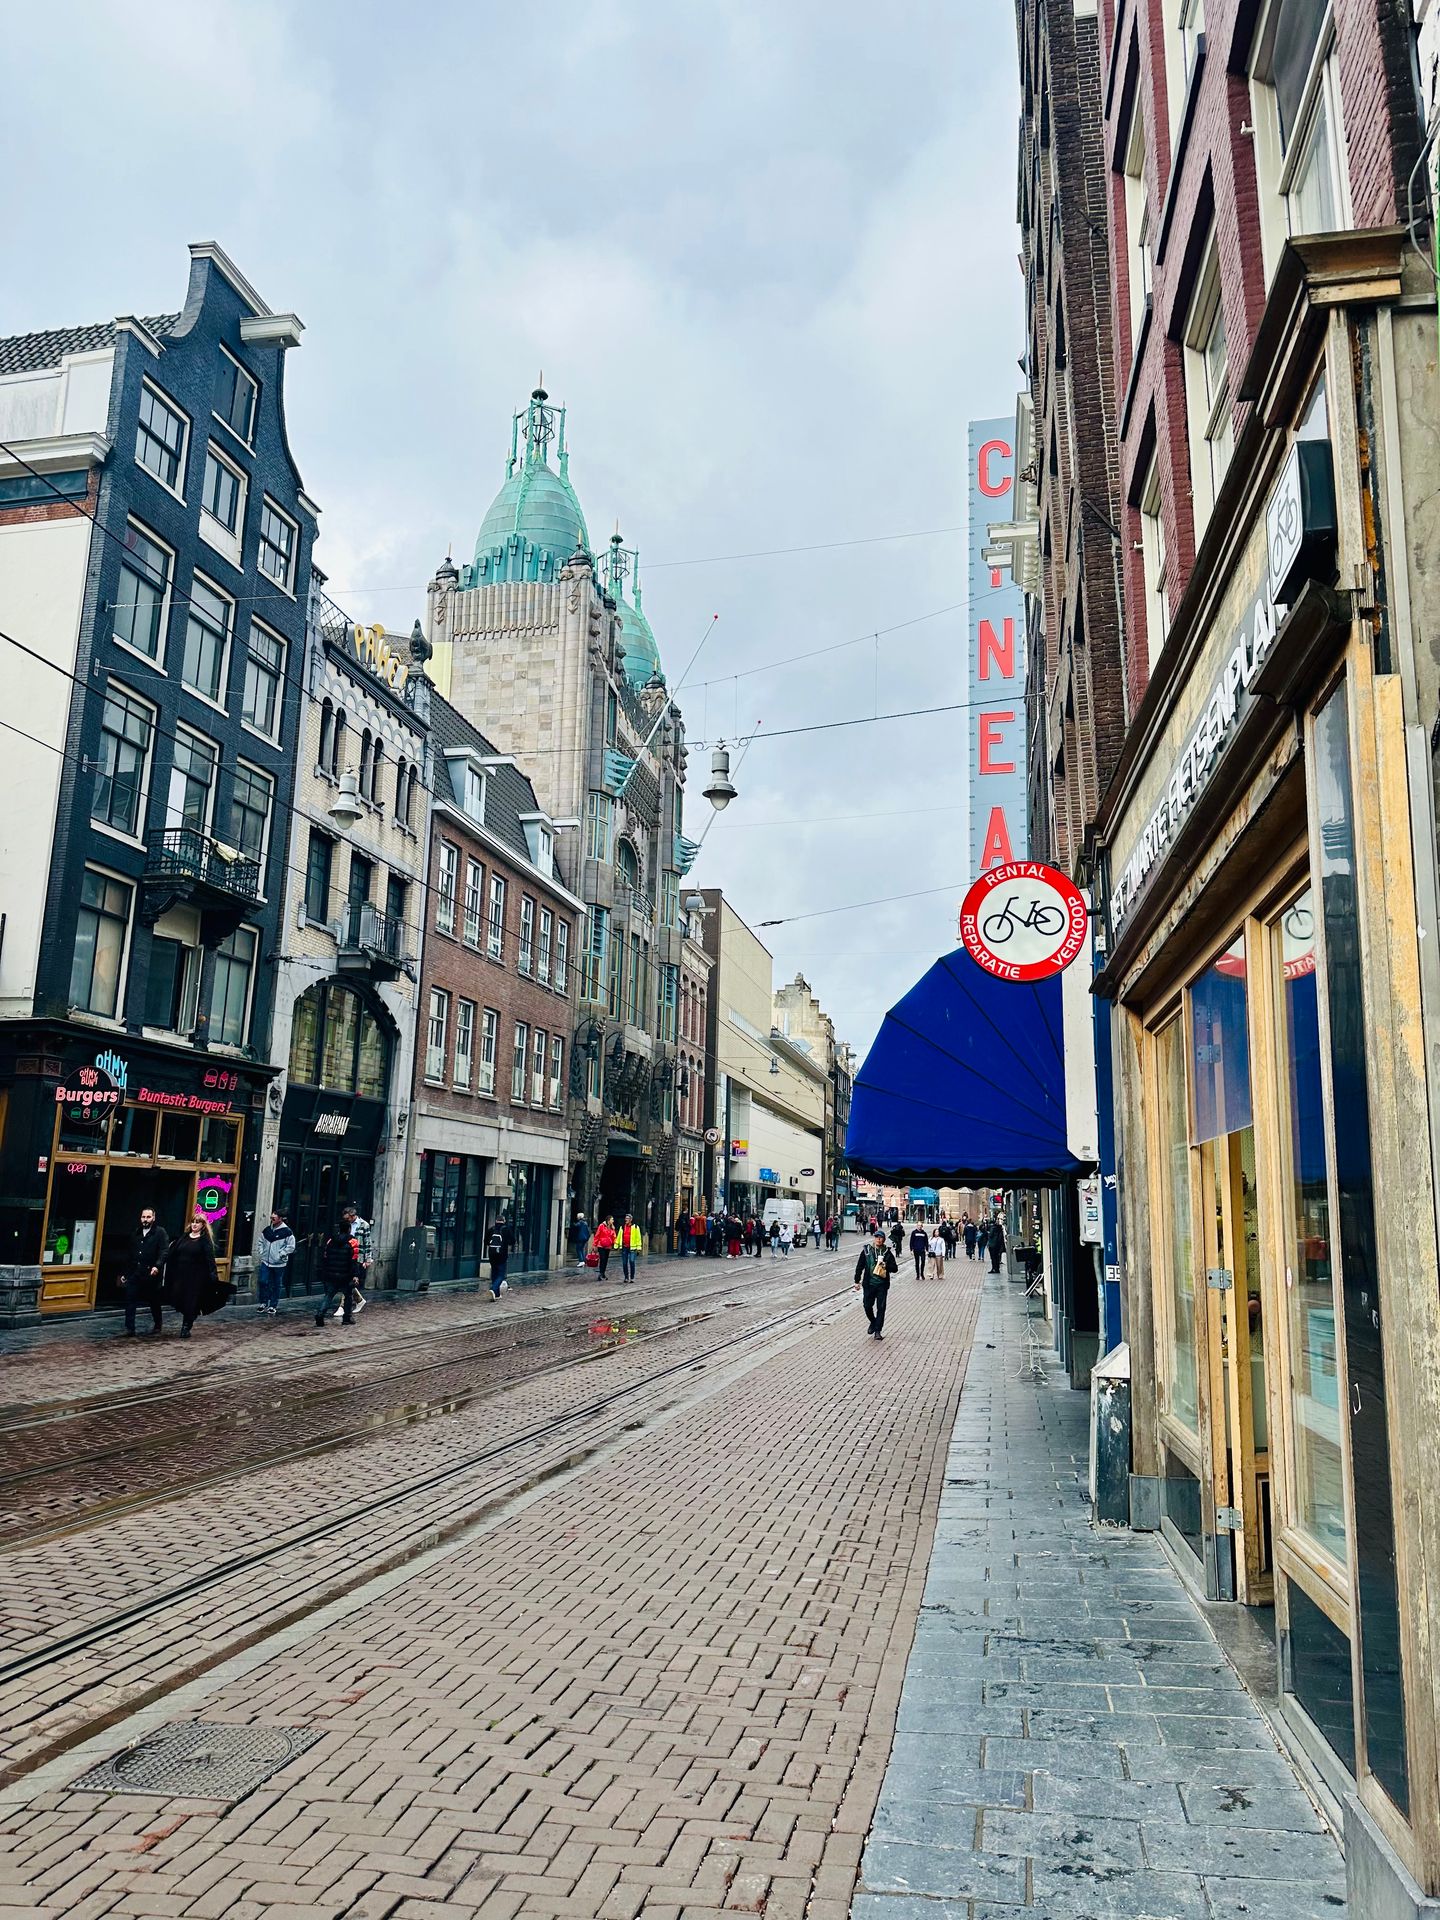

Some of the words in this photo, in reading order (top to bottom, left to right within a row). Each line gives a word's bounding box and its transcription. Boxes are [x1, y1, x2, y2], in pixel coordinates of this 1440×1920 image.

[985, 864, 1045, 886] RENTAL
[1051, 896, 1085, 966] VERKOOP
[963, 914, 1021, 978] REPARATIE
[55, 1086, 118, 1106] Burgers
[138, 1087, 188, 1108] Buntastic
[188, 1095, 232, 1114] Burgers!
[67, 1163, 87, 1175] open
